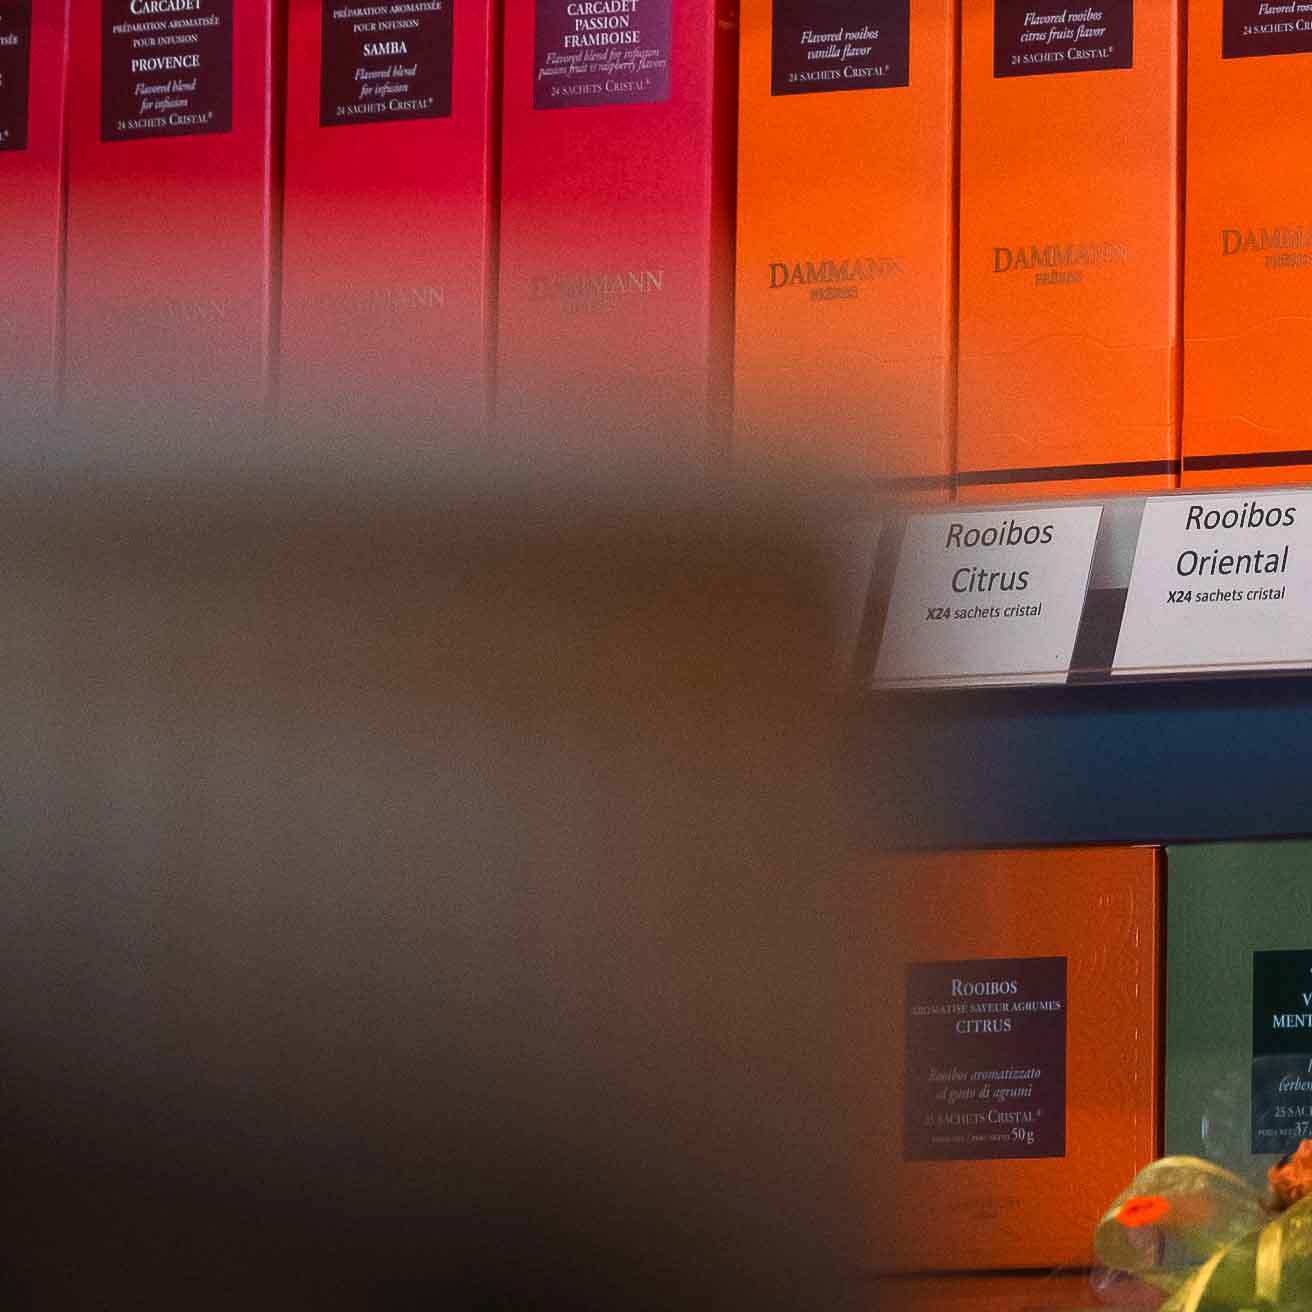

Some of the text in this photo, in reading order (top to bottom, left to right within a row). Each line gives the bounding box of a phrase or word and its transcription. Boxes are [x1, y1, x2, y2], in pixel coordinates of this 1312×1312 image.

[566, 0, 639, 17] CARCADET
[574, 15, 630, 30] PASSION
[363, 40, 407, 57] SAMBA
[563, 30, 640, 48] FRAMBOISE
[131, 53, 200, 73] PROVENCE
[1186, 503, 1296, 531] Rooibos
[946, 520, 1054, 548] Rooibos
[1176, 546, 1289, 577] Oriental
[951, 566, 1029, 594] Citrus
[951, 978, 1017, 997] ROOIBOS
[956, 1017, 1011, 1033] CITRUS
